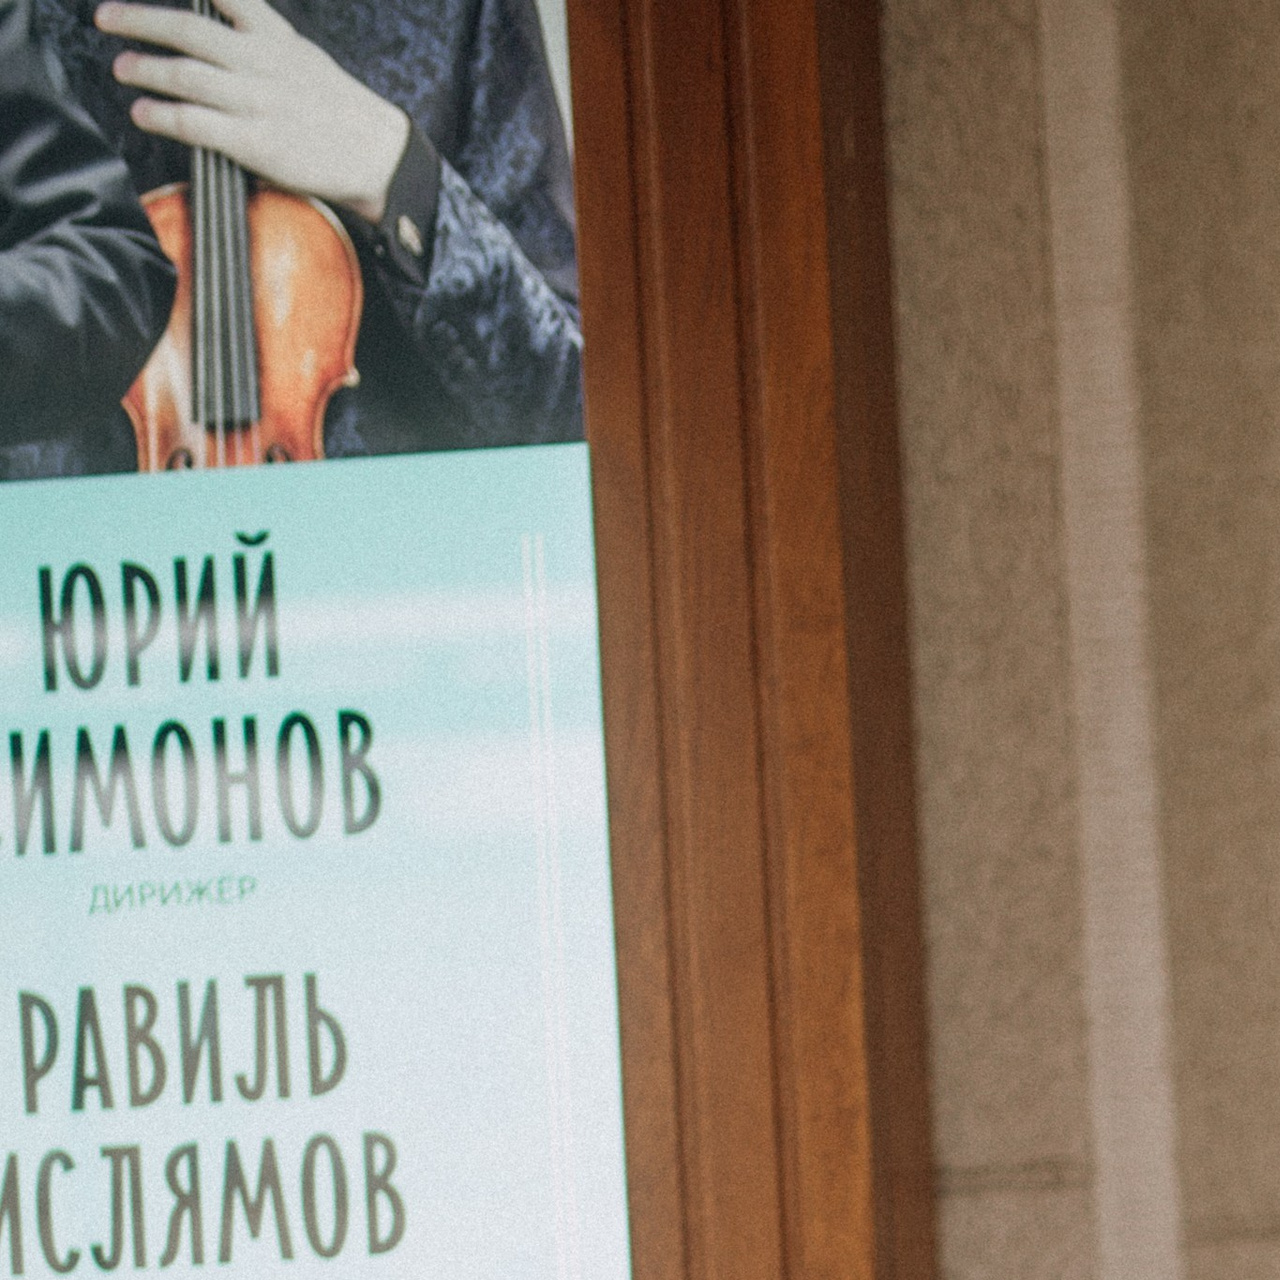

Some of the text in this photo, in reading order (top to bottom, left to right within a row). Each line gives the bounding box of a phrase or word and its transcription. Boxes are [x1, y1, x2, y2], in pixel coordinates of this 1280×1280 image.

[37, 530, 279, 692] ЮРИЙ
[0, 709, 381, 858] ИМОНОВ
[89, 876, 258, 914] ДИРИЖЕР
[18, 972, 348, 1114] РАВИЛЬ
